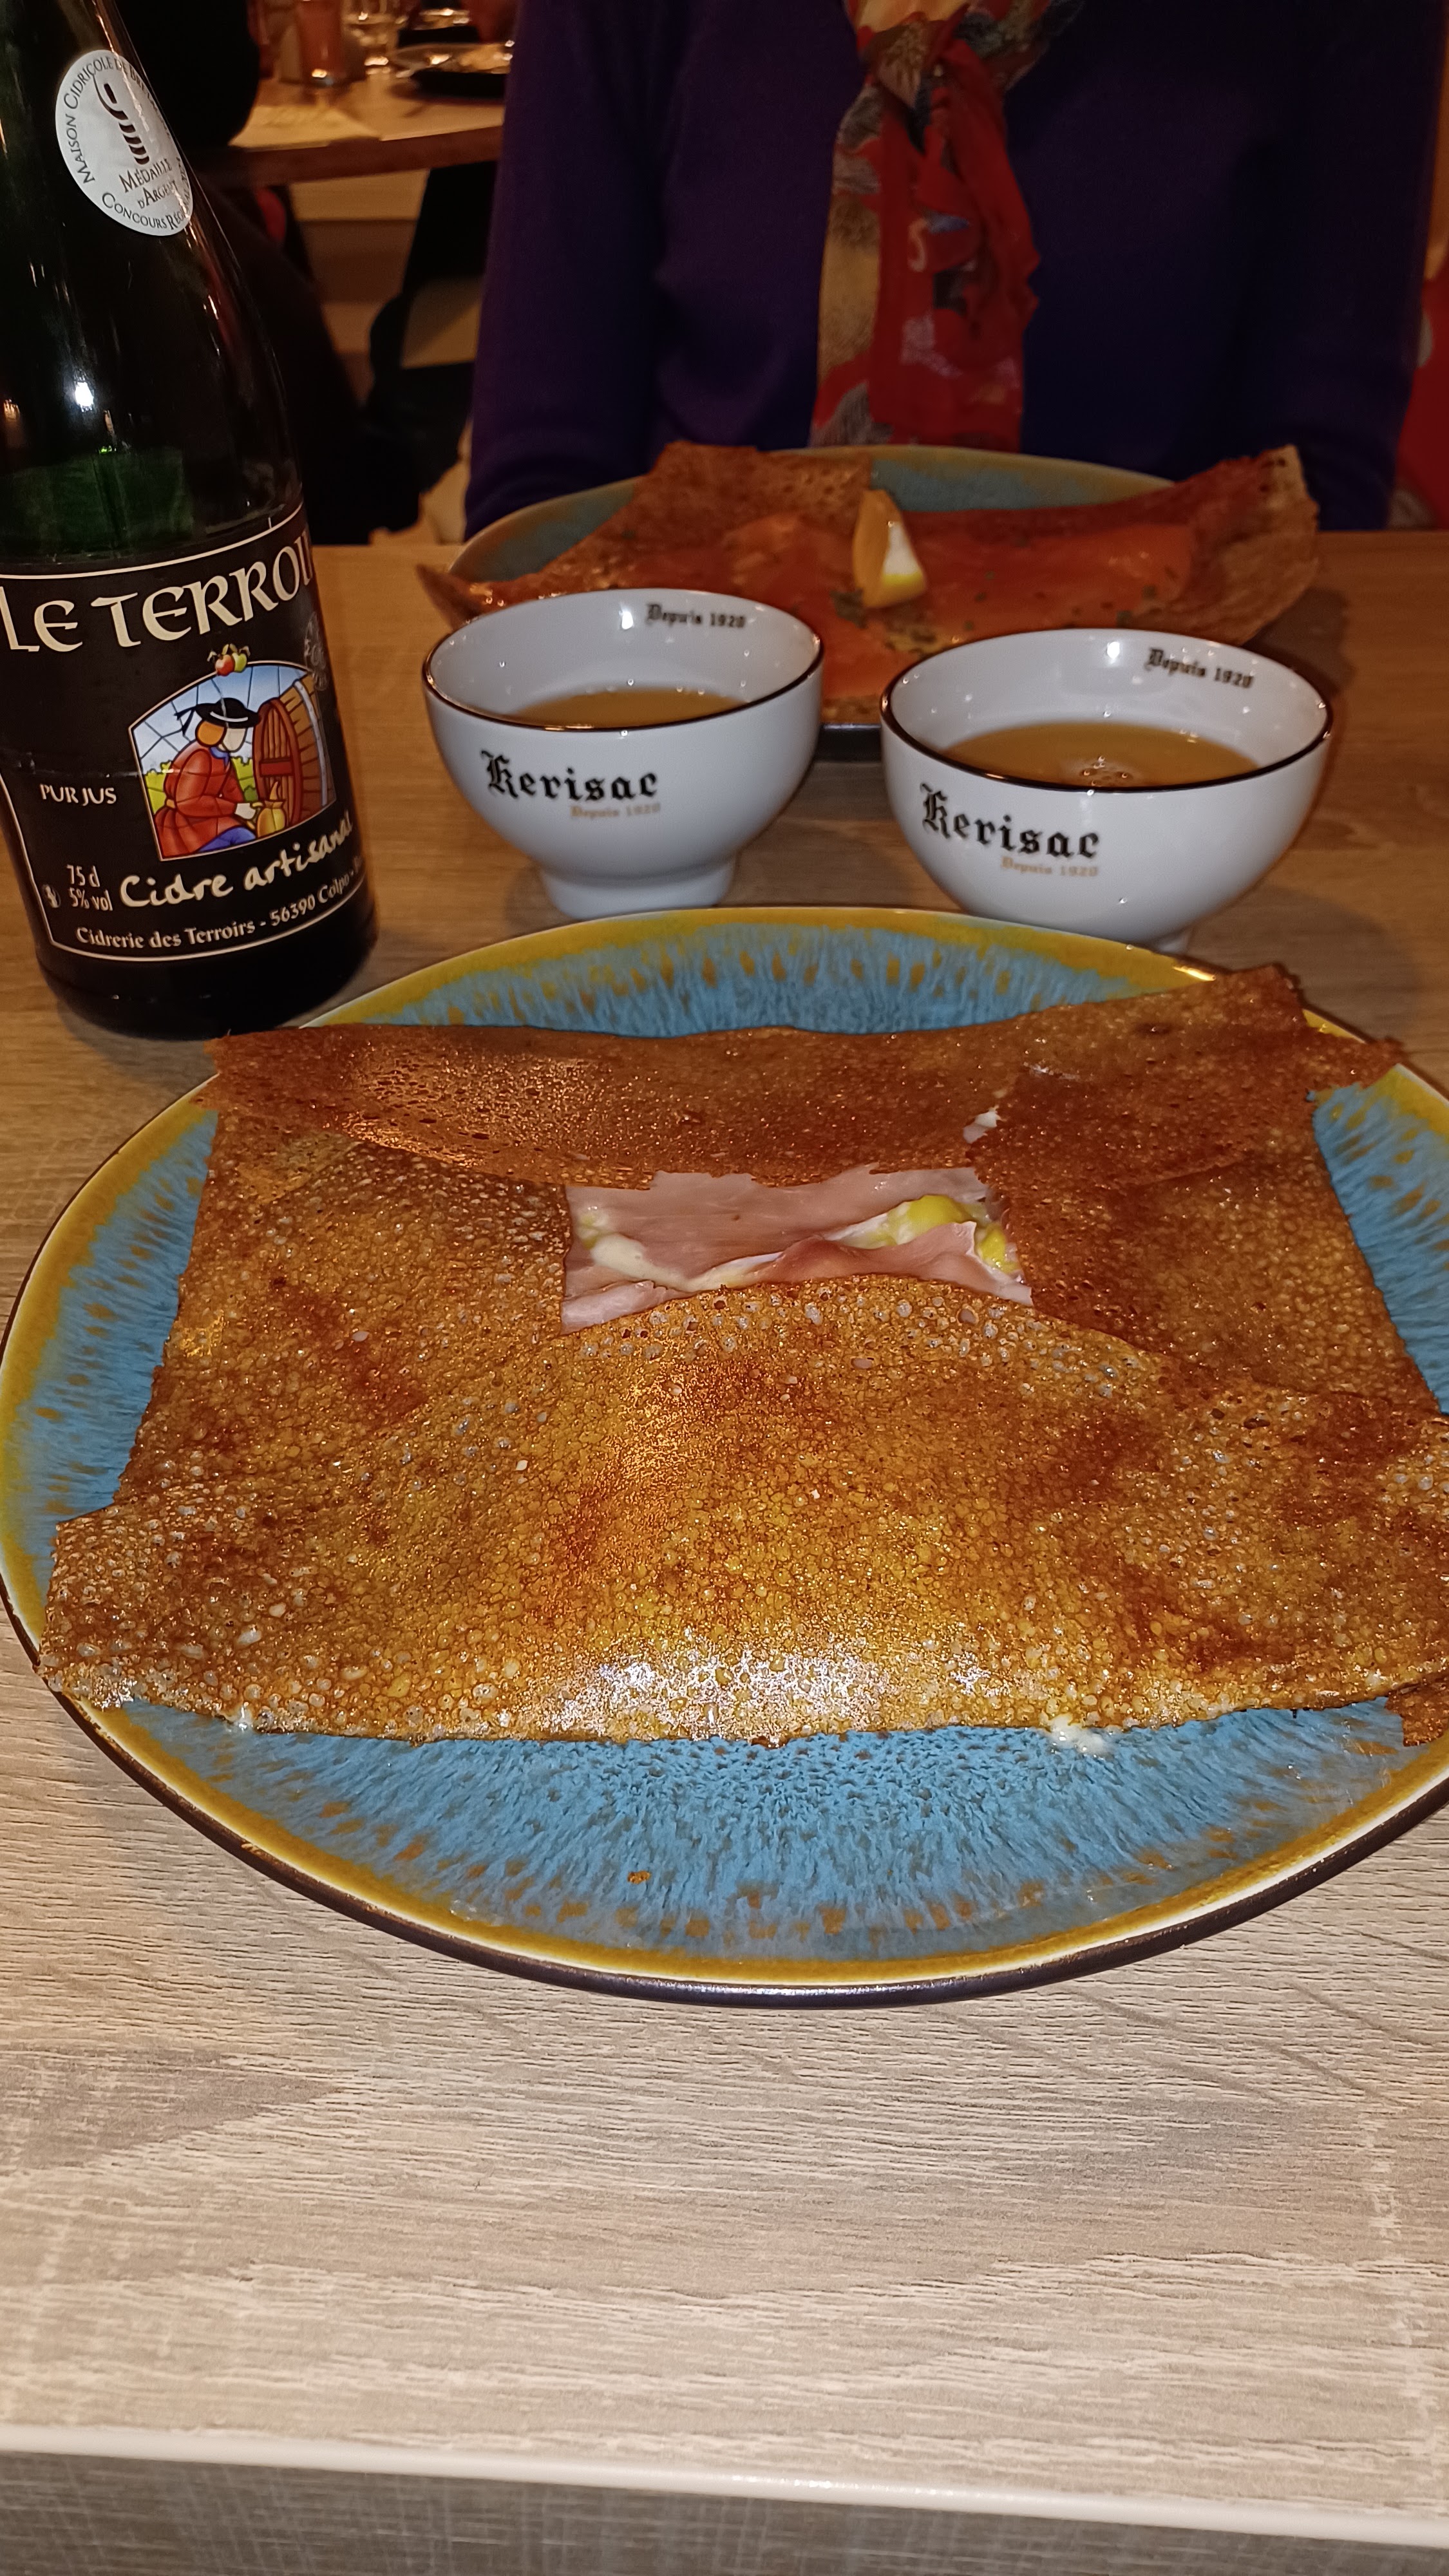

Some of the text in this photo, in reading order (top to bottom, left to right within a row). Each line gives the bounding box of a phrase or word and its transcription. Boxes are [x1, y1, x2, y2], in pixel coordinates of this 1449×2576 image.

[63, 55, 114, 110] CIDRICOLE
[65, 113, 96, 184] MAISON
[101, 192, 167, 229] CONCOURS
[0, 586, 83, 652] LE
[710, 612, 746, 629] 1920
[1144, 647, 1255, 688] Depuis 1920
[39, 783, 117, 806] PUR JUS
[480, 749, 658, 802] Kerisac
[920, 782, 1099, 860] Kerisac
[66, 864, 86, 886] 75
[120, 873, 234, 908] Cidre
[76, 926, 144, 949] Cidrerie
[148, 931, 182, 949] des
[184, 920, 256, 945] Terroirs
[269, 893, 316, 927] 56390
[90, 889, 113, 912] vol
